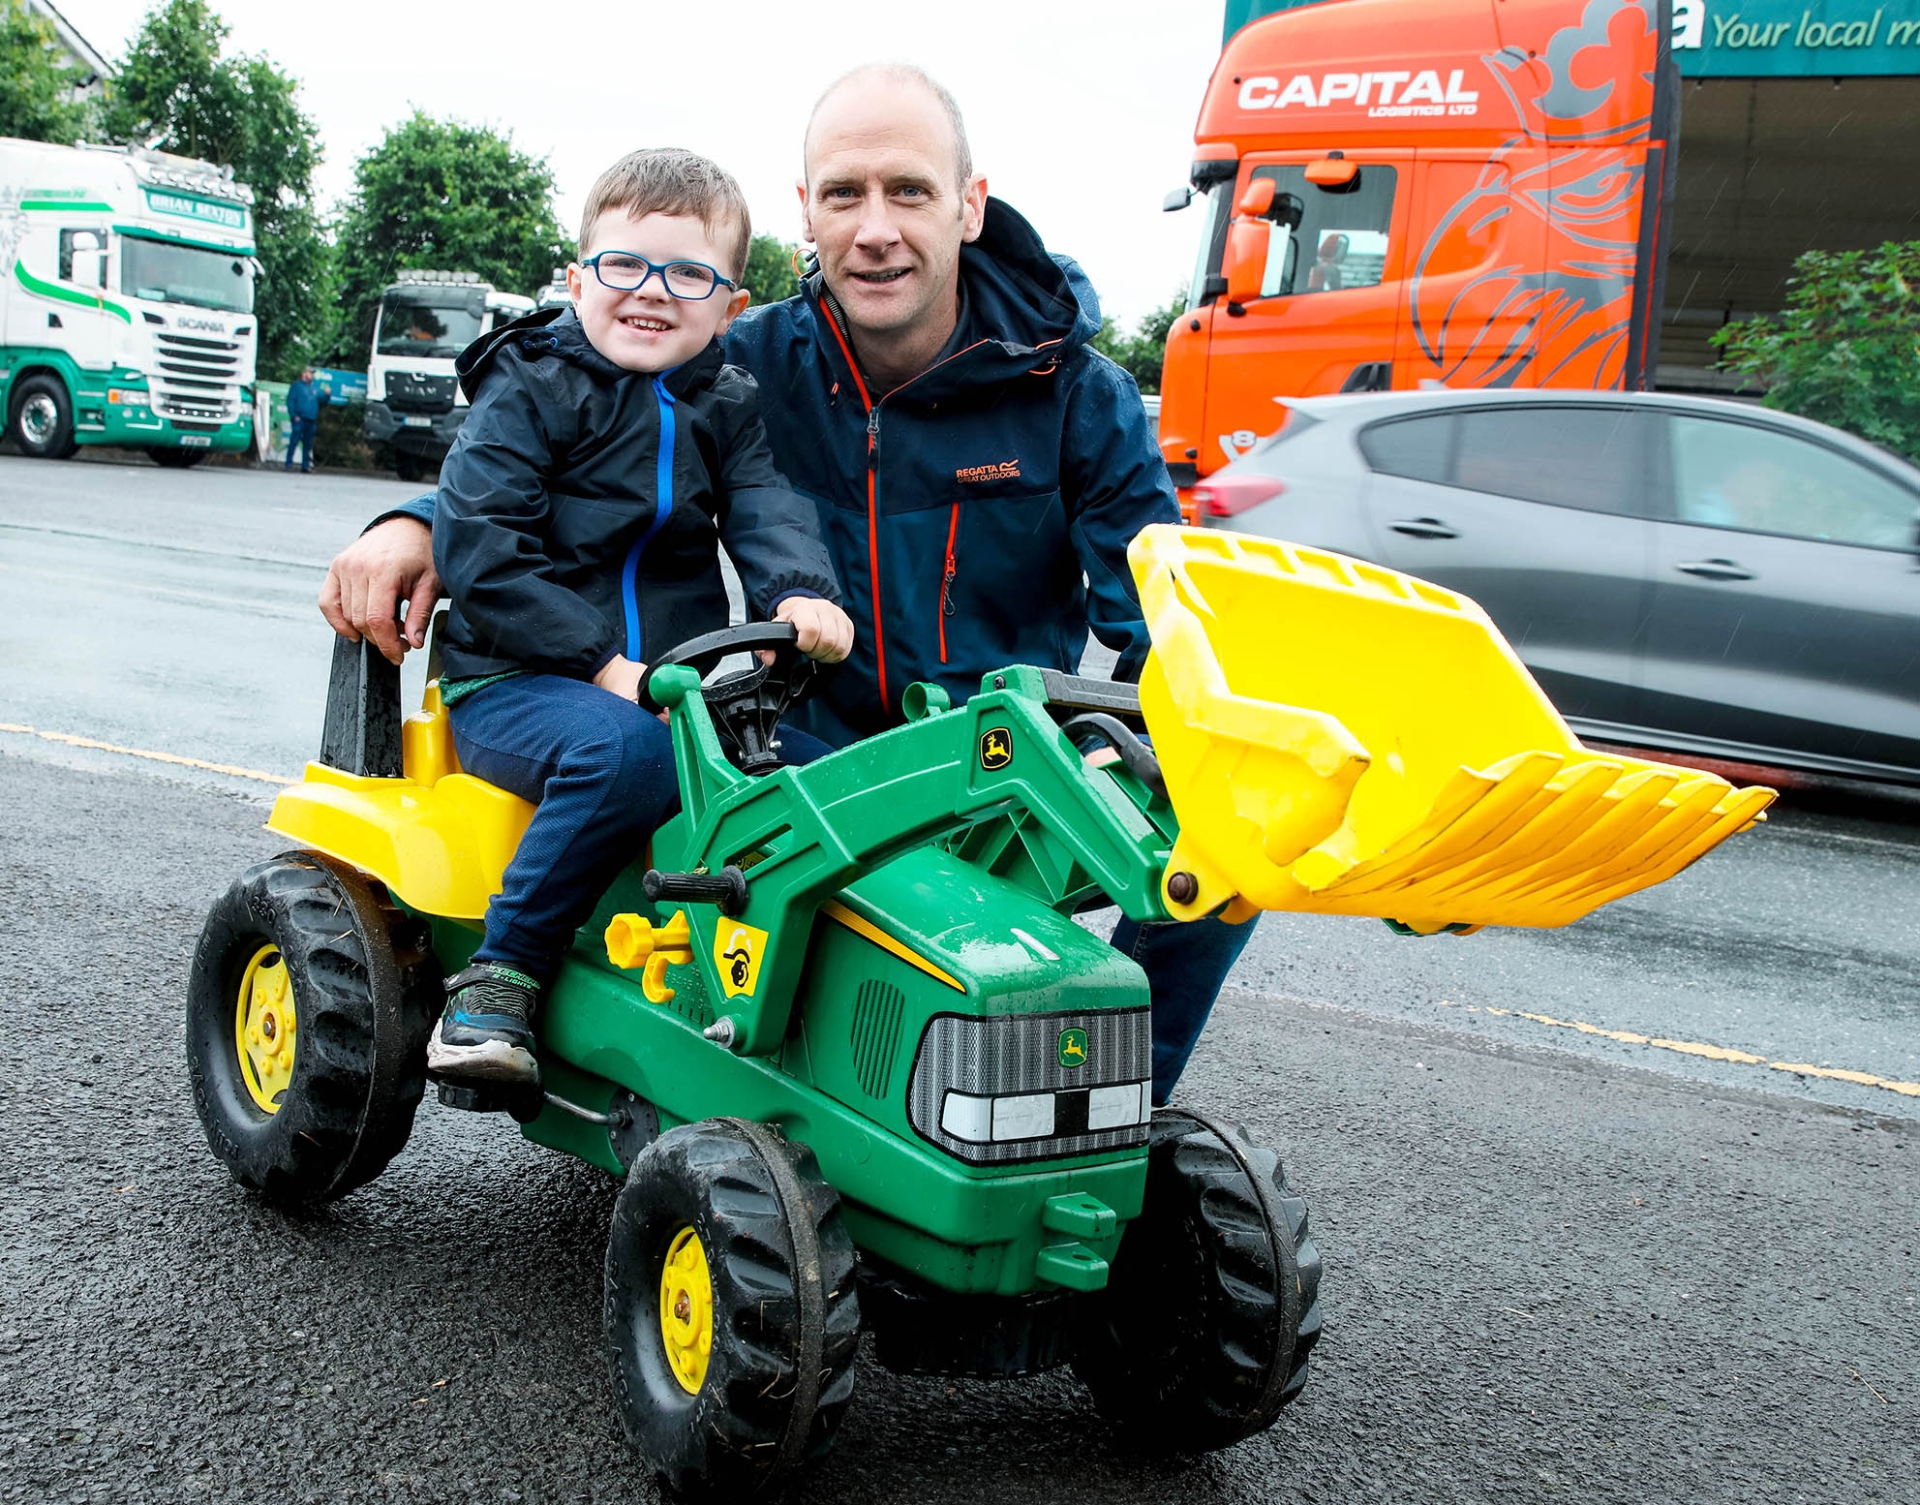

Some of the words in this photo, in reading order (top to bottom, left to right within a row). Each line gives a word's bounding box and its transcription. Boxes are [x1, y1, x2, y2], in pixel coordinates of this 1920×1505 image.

[1713, 13, 1792, 48] Your
[1794, 9, 1882, 47] local
[1237, 69, 1479, 110] CAPITAL
[1368, 104, 1446, 118] LOGISTICS
[1448, 103, 1478, 116] LTD
[177, 317, 225, 333] SCANIA
[955, 464, 999, 478] REGATTA
[979, 469, 1021, 482] OUTDOORS
